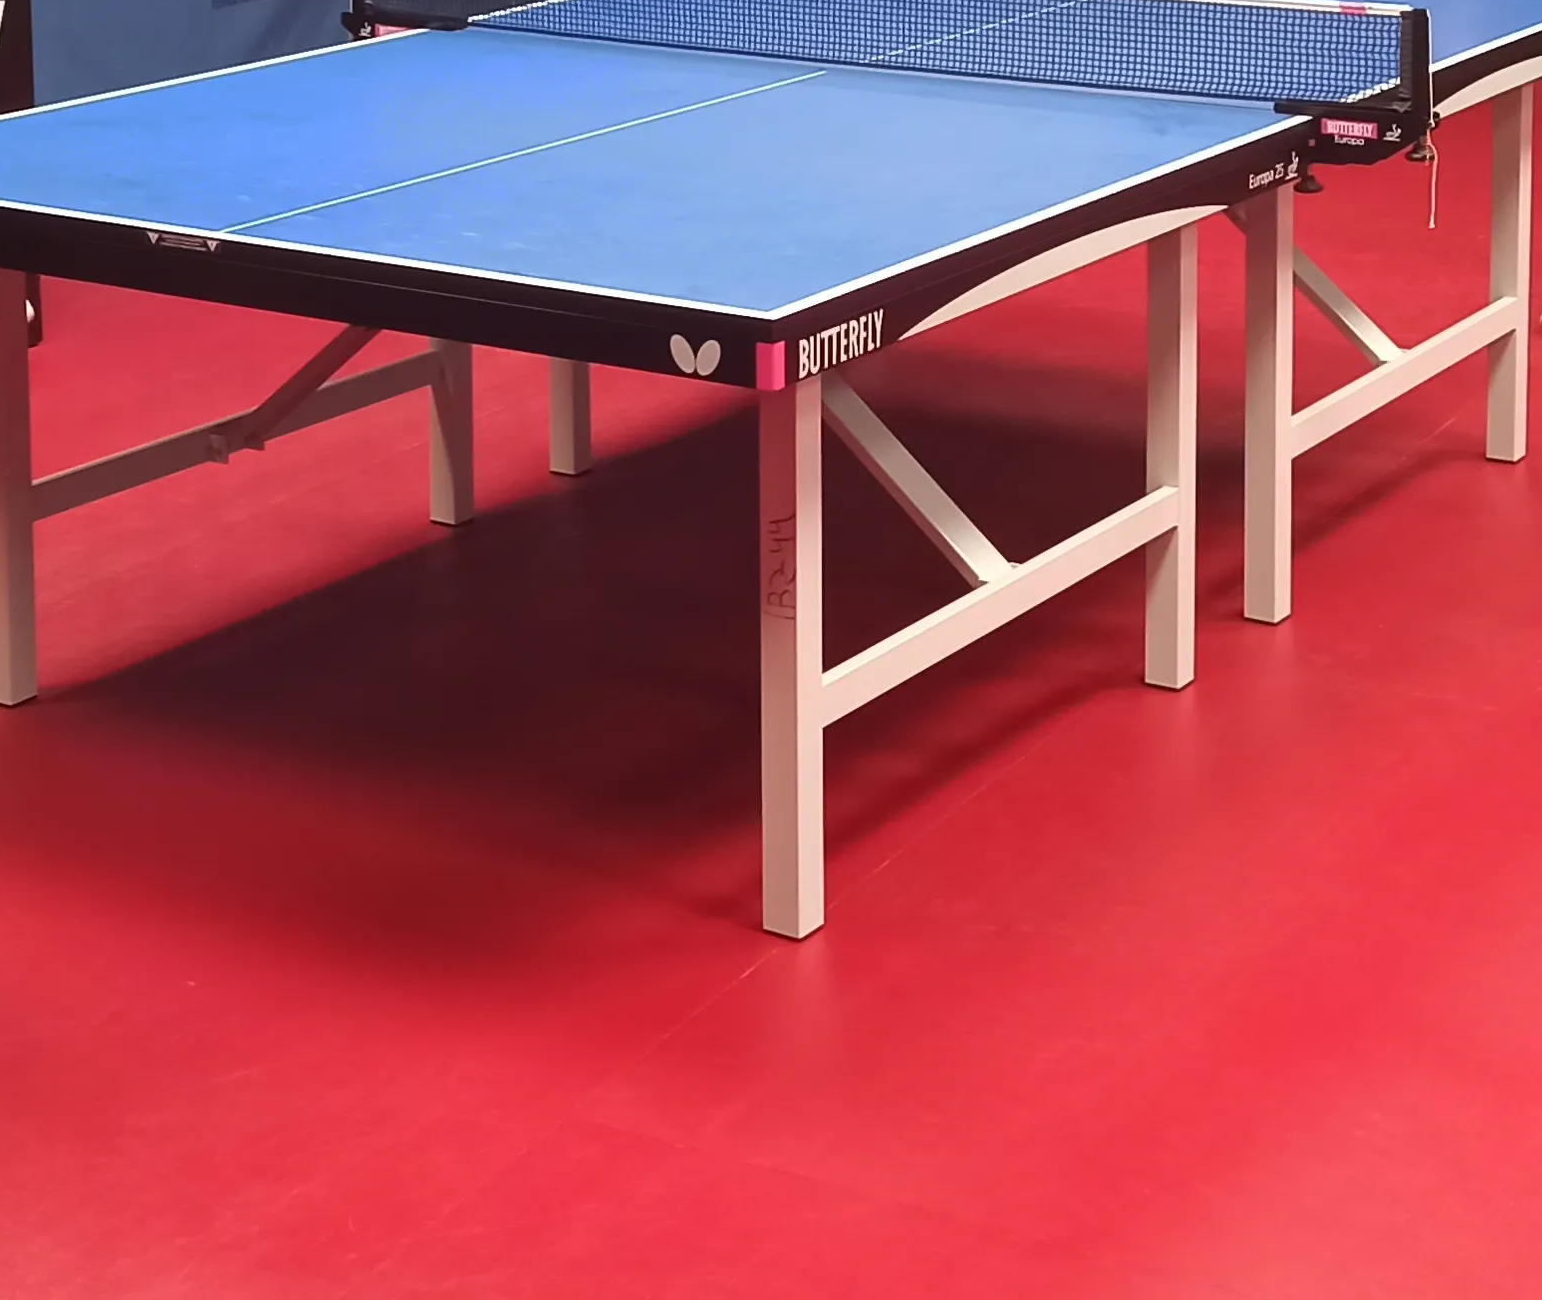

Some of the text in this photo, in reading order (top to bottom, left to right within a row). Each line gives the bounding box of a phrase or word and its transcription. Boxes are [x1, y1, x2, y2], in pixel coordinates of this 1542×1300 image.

[1326, 120, 1373, 137] BUTTERFLY
[1249, 163, 1285, 190] Europa 25
[798, 308, 884, 380] BUTTERFLY
